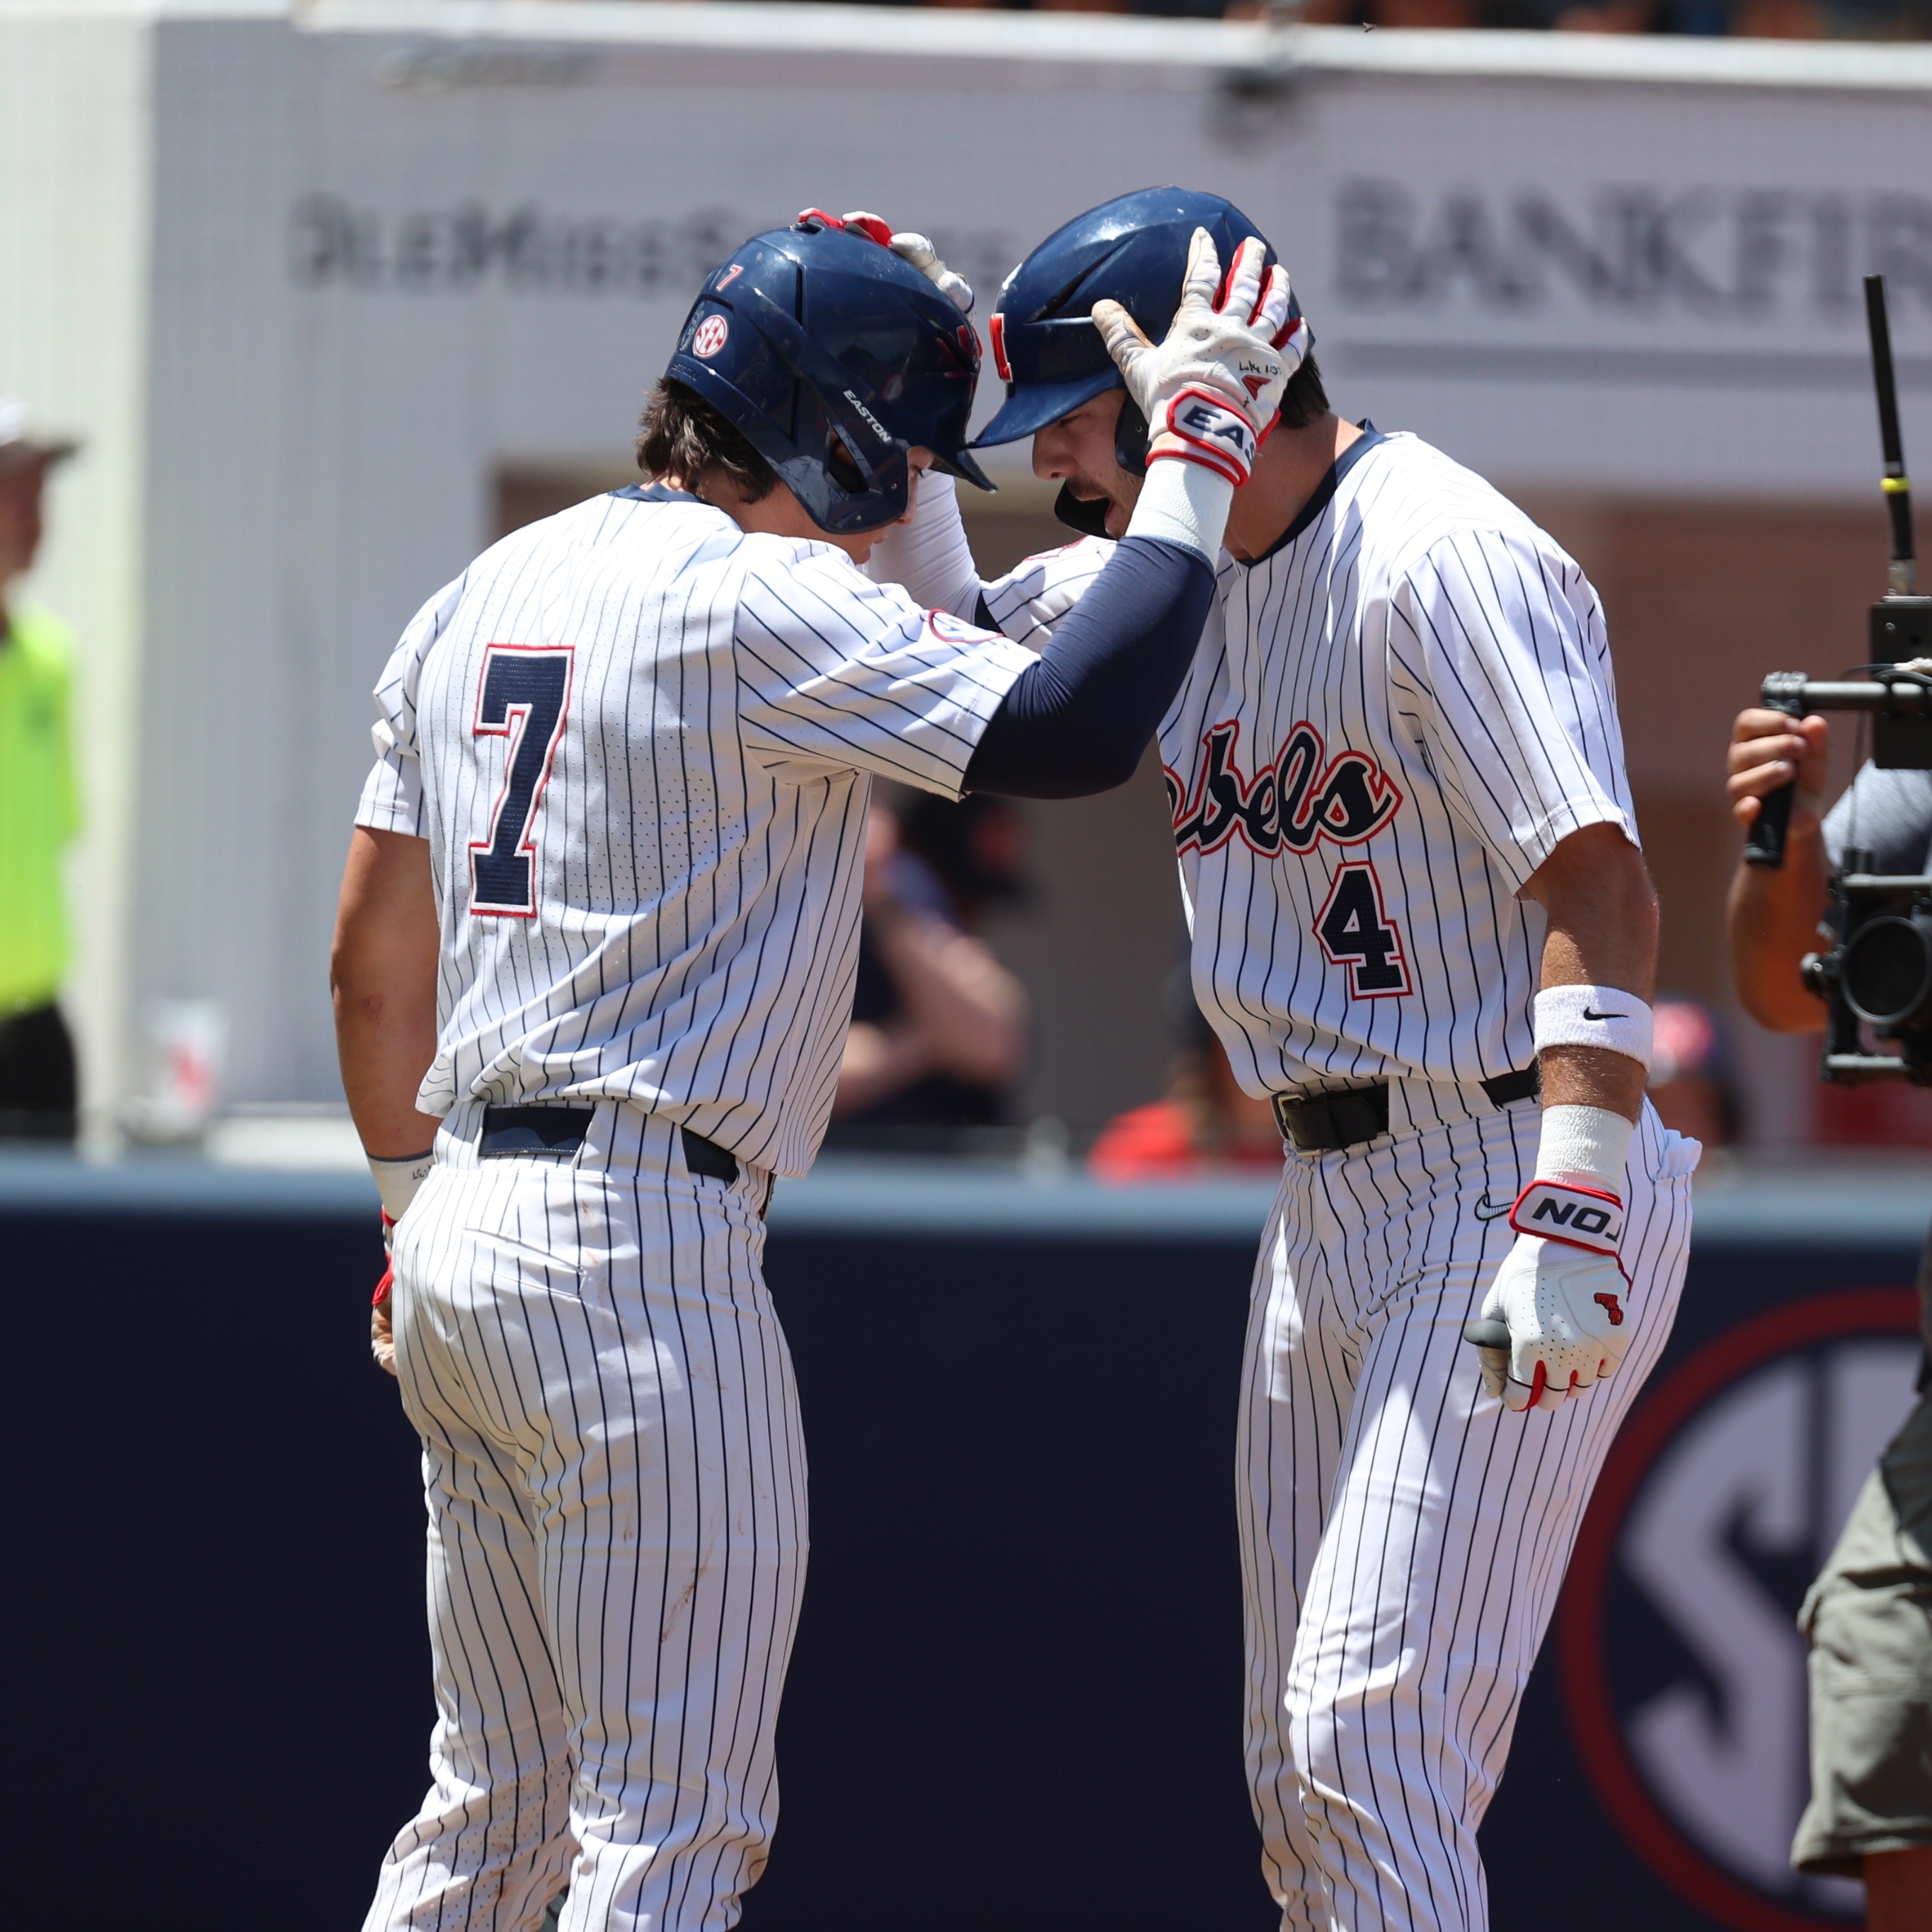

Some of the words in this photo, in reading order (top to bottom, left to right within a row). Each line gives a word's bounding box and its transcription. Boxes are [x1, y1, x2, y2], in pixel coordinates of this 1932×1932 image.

[716, 265, 744, 292] 7
[693, 314, 728, 357] SEC
[843, 389, 892, 442] EASTON
[468, 643, 576, 919] 7
[1312, 861, 1413, 1001] 4
